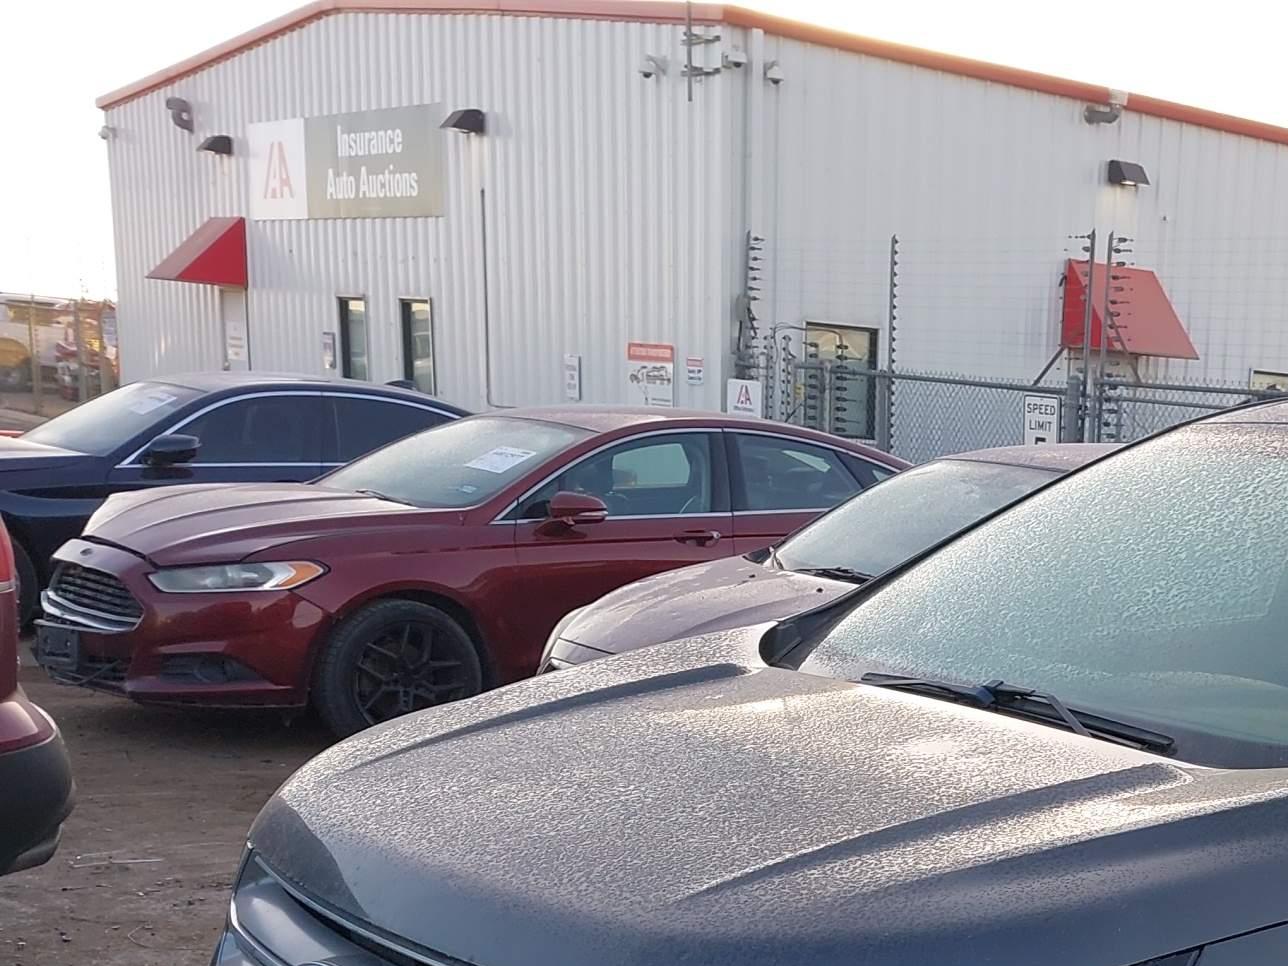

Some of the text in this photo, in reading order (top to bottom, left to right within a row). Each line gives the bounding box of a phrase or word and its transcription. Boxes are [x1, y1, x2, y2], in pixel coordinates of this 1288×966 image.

[337, 125, 403, 157] Insurance
[327, 165, 418, 200] Auto Auctions
[1027, 403, 1056, 416] SPEED
[1029, 419, 1053, 432] LIMIT
